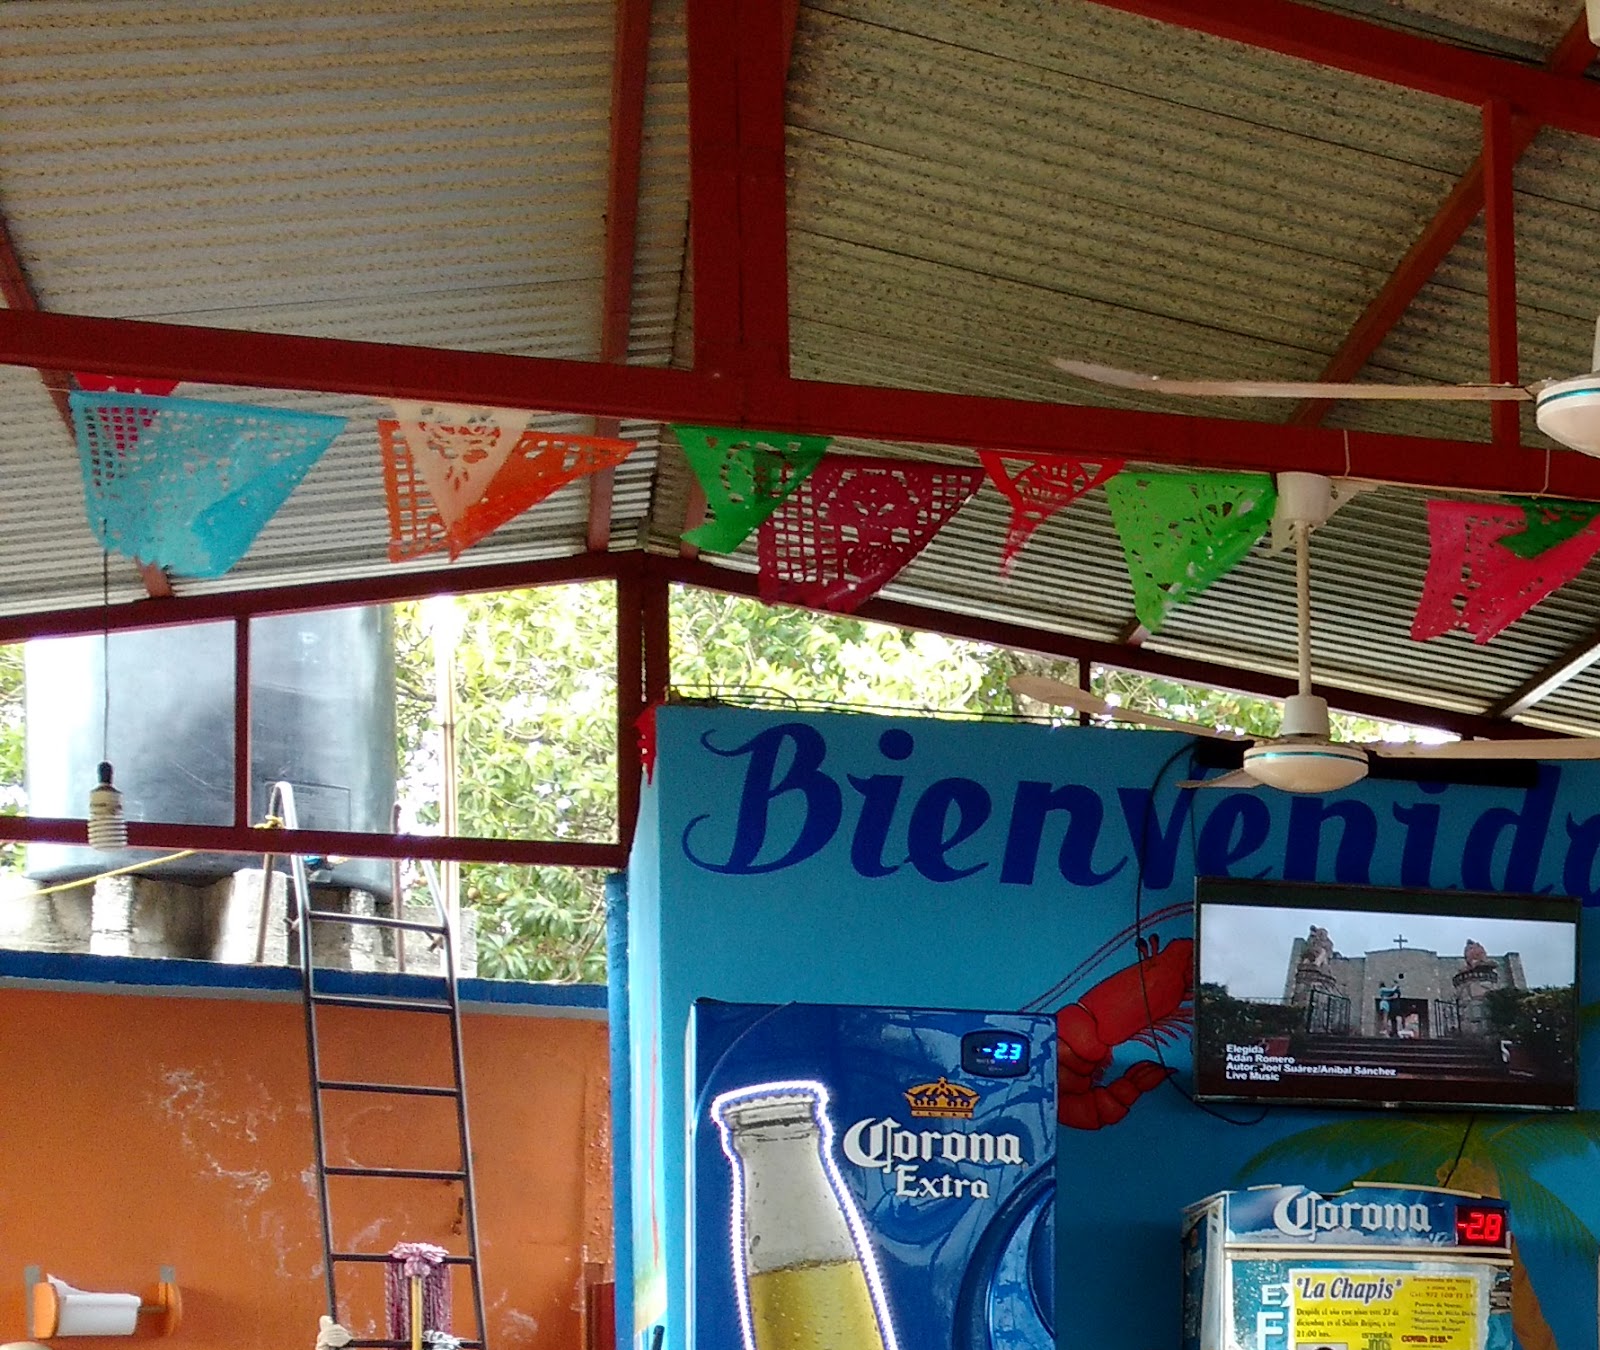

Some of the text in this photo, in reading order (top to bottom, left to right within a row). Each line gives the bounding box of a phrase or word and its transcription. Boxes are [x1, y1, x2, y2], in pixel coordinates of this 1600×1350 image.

[1226, 1044, 1264, 1055] Elegida
[1255, 1055, 1295, 1064] Romero
[1260, 1063, 1281, 1072] Joel
[1226, 1071, 1279, 1081] Live Music
[843, 1117, 1023, 1174] Corona
[895, 1164, 990, 1199] Extra
[1273, 1191, 1432, 1242] Corona
